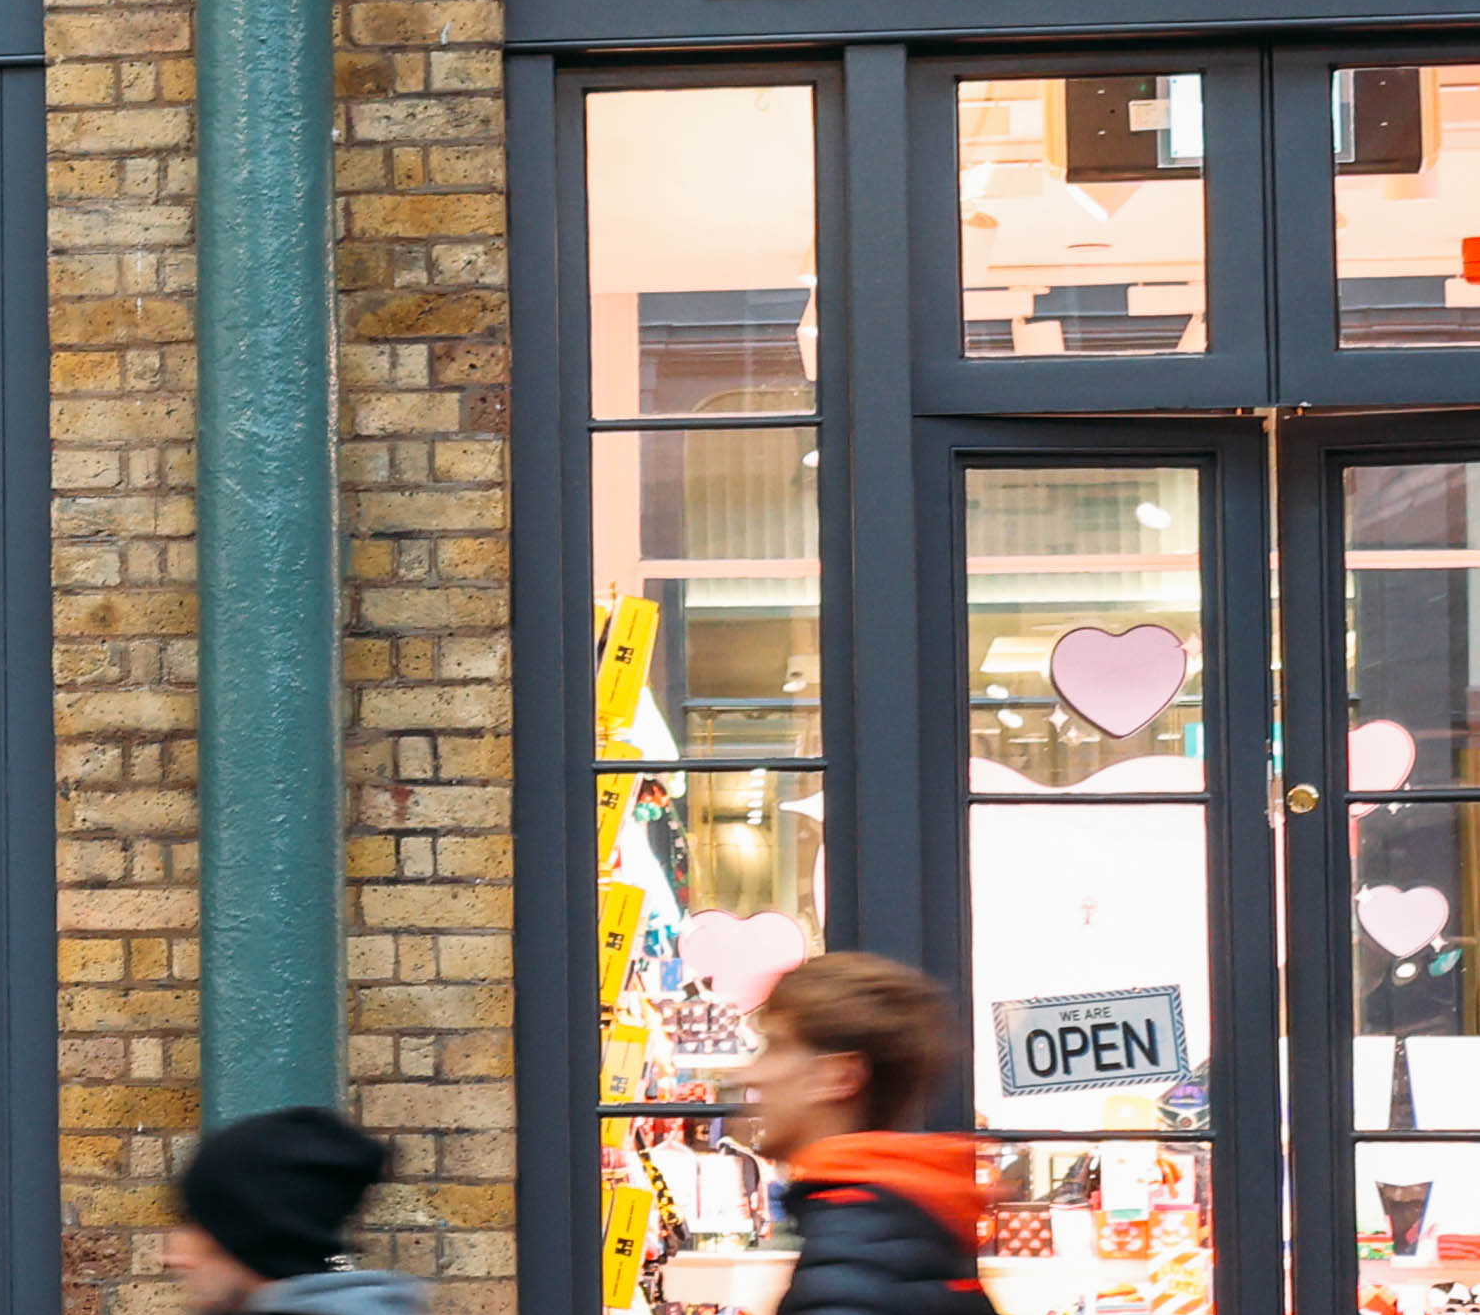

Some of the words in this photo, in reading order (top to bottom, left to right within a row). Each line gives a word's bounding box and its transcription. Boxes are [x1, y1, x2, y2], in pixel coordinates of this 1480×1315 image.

[1058, 1009, 1081, 1022] WE
[1084, 1006, 1113, 1021] ARE
[1025, 1018, 1161, 1078] OPEN
